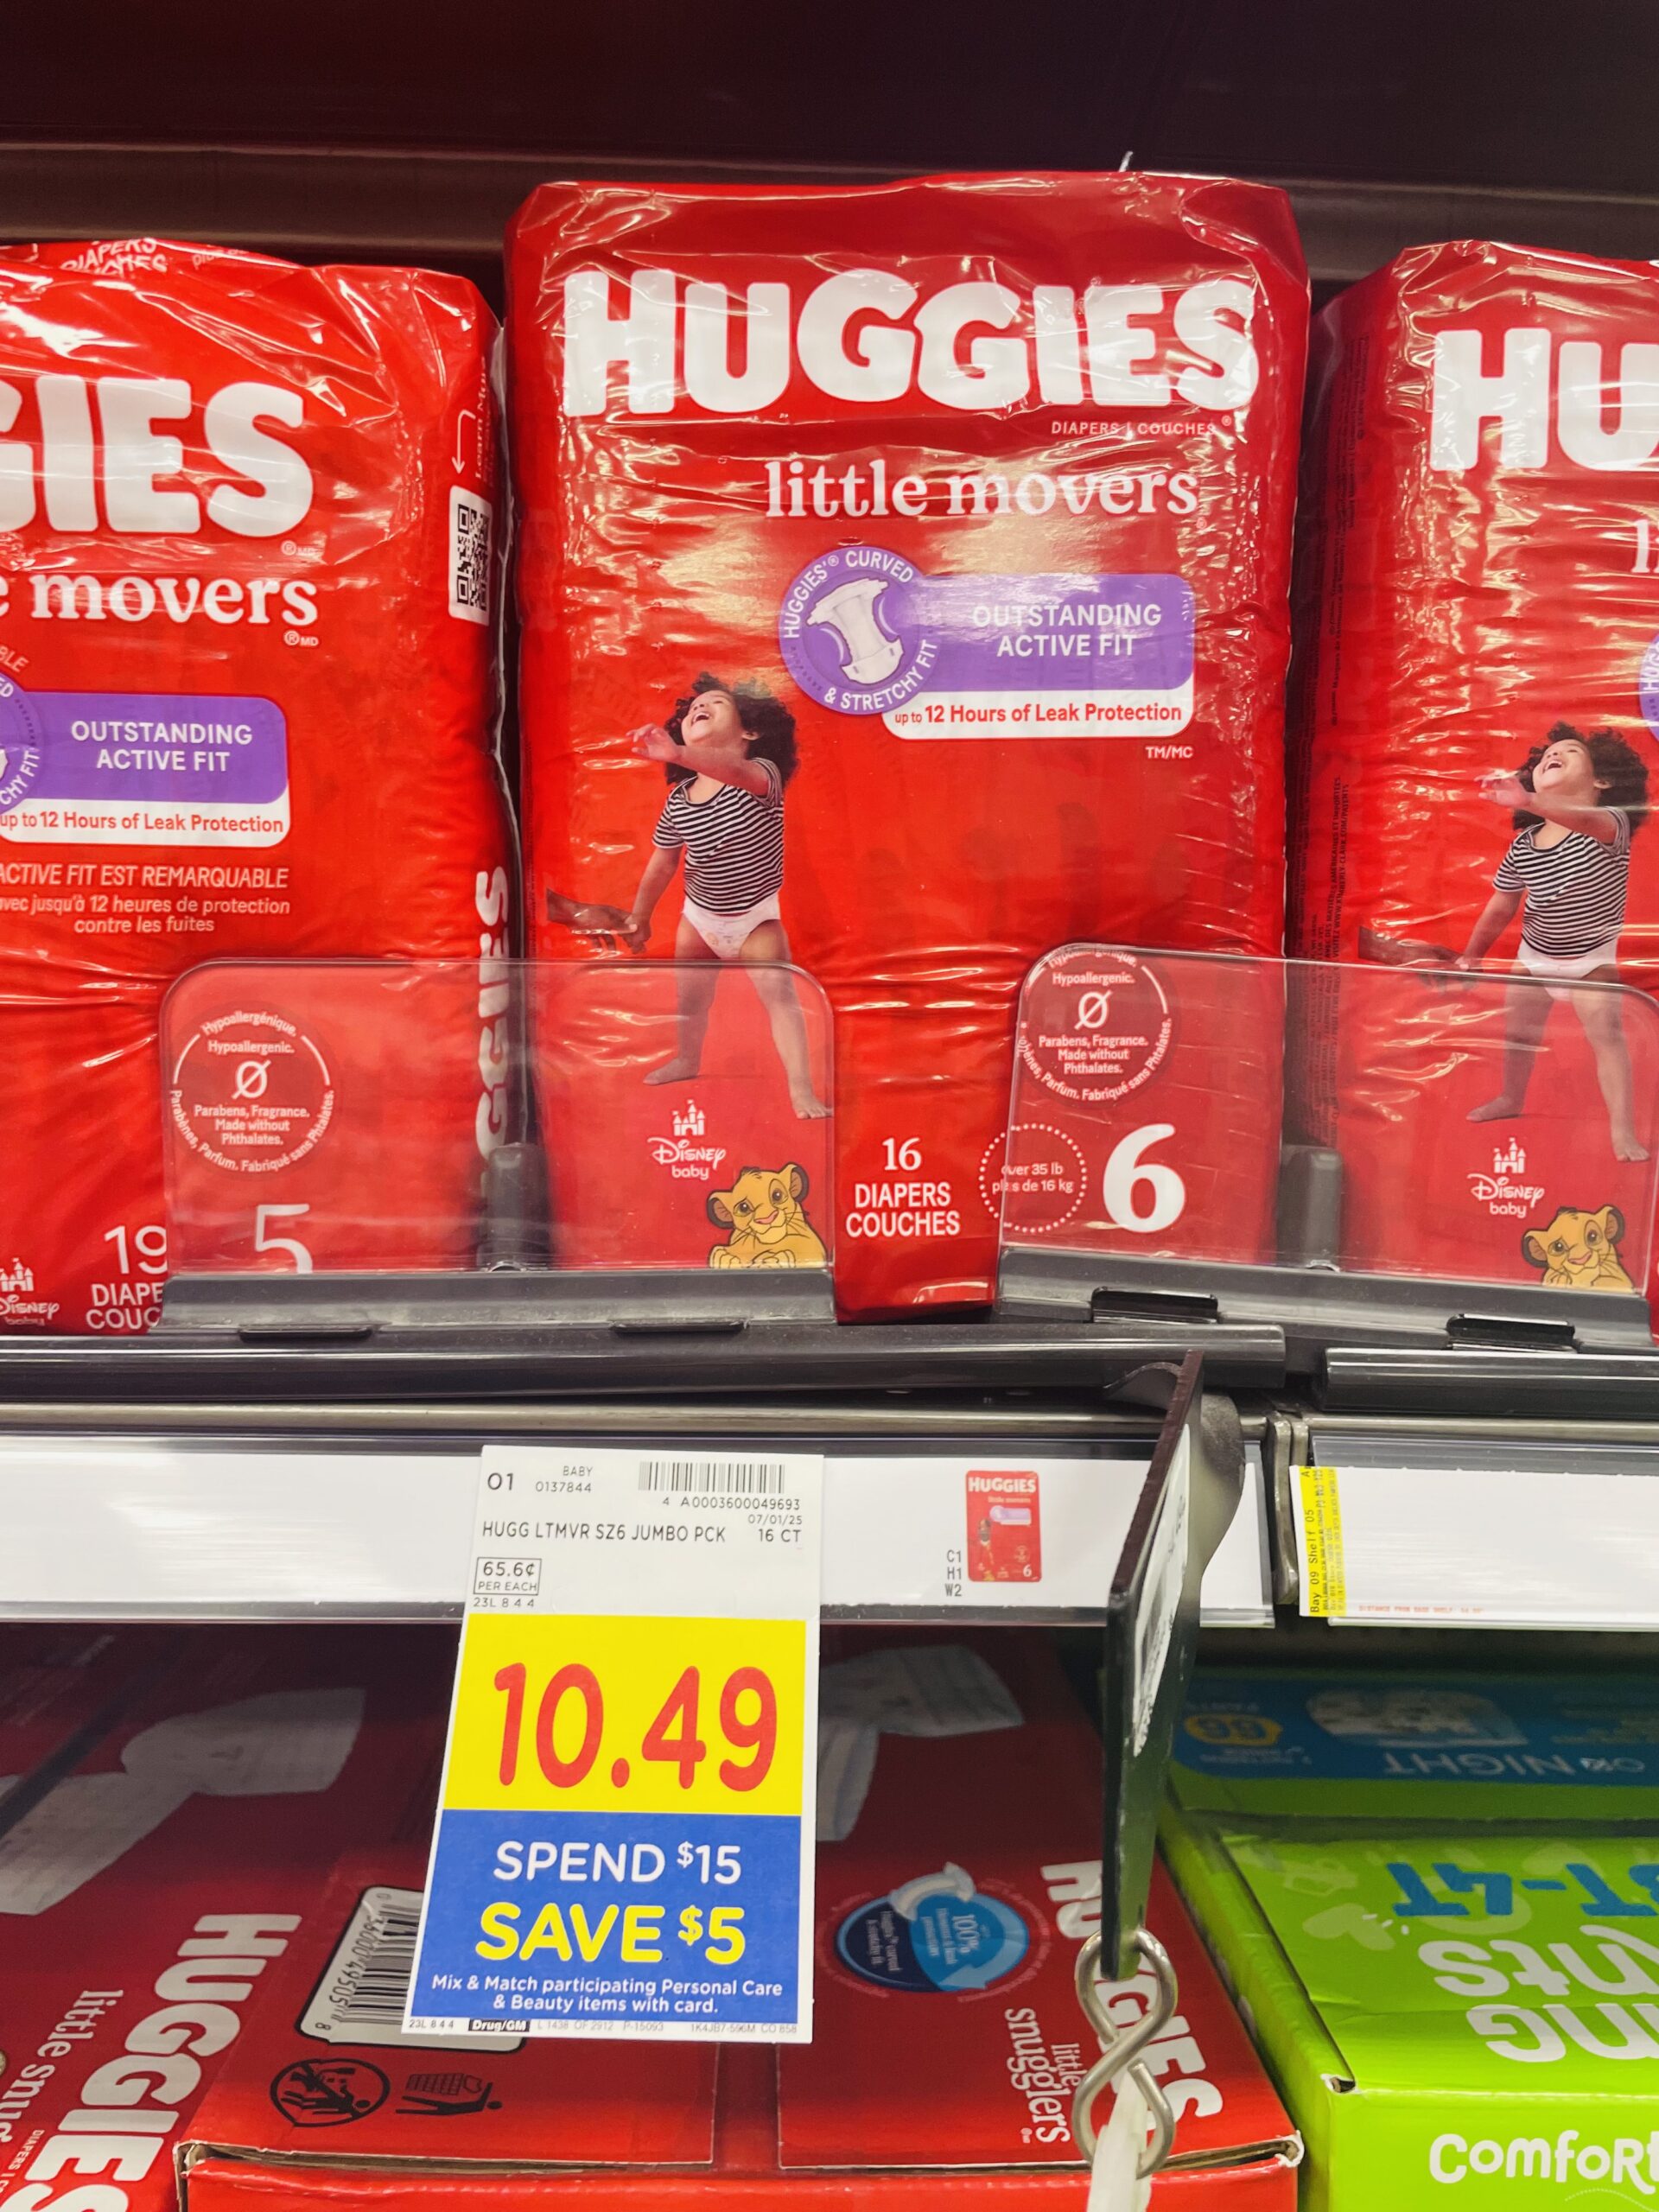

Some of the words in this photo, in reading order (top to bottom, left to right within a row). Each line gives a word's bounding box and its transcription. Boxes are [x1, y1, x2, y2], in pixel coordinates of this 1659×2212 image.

[563, 266, 1261, 418] HUGGIES
[1051, 421, 1120, 435] DIAPERS
[1137, 422, 1217, 435] COUCHES
[0, 374, 315, 537] IES
[764, 459, 931, 518] little
[946, 471, 1199, 516] movers
[845, 550, 914, 583] CURVED
[29, 574, 318, 627] movers
[972, 603, 1163, 627] OUTSTANDING
[996, 633, 1092, 658] ACTIVE
[1098, 633, 1138, 657] FIT
[823, 687, 837, 705] &
[840, 665, 925, 711] STRETCHY
[915, 639, 938, 669] FIT
[894, 713, 909, 727] up
[910, 712, 923, 724] to
[925, 705, 945, 723] 12
[950, 704, 1007, 723] Hours
[1011, 703, 1032, 722] of
[1035, 702, 1080, 721] Leak
[1084, 702, 1182, 721] Protection
[70, 720, 253, 746] OUTSTANDING
[19, 749, 41, 778] FIT
[95, 748, 188, 772] ACTIVE
[193, 750, 232, 772] FIT
[1145, 746, 1194, 760] TM/MC
[0, 815, 18, 831] up
[22, 814, 38, 828] to
[40, 810, 59, 828] 12
[63, 811, 118, 830] Hours
[122, 812, 141, 830] of
[144, 813, 188, 831] Leak
[191, 815, 284, 834] Protection
[66, 863, 97, 886] FIT
[100, 864, 138, 887] EST
[141, 865, 290, 889] REMARQUABLE
[90, 894, 109, 912] 12
[112, 895, 172, 912] heures
[176, 895, 199, 912] de
[202, 897, 290, 916] protection
[74, 918, 131, 933] contre
[136, 917, 162, 932] les
[166, 916, 215, 933] fuites
[1052, 971, 1136, 987] Hypoallergenic.
[200, 1010, 297, 1037] Hypoallergénique.
[474, 865, 511, 1163] GGIES
[207, 1039, 296, 1056] Hypoallergenic.
[1038, 1034, 1091, 1049] Parabens,
[1092, 1034, 1149, 1049] Fragrance.
[1040, 1072, 1081, 1100] Parfum.
[1082, 1081, 1129, 1102] Fabriqué
[1128, 1069, 1151, 1090] sans
[1145, 1017, 1173, 1071] Phtalates.
[1058, 1049, 1087, 1061] Made
[1089, 1048, 1129, 1061] without
[1064, 1062, 1123, 1075] Phthalates.
[193, 1104, 251, 1119] Parabens,
[251, 1104, 311, 1120] Fragrance.
[197, 1142, 239, 1172] Parfum.
[240, 1153, 292, 1173] Fabriqué
[289, 1141, 314, 1161] sans
[308, 1090, 335, 1143] Phtalates.
[214, 1119, 246, 1132] Made
[247, 1119, 291, 1132] without
[221, 1133, 284, 1146] Phthalates.
[646, 1136, 727, 1170] Disney
[880, 1136, 923, 1172] 16
[671, 1165, 710, 1181] baby
[1031, 1163, 1048, 1175] 35
[1050, 1161, 1064, 1175] lb
[1103, 1122, 1186, 1234] 6
[854, 1181, 951, 1209] DIAPERS
[1021, 1179, 1039, 1192] de
[1040, 1179, 1056, 1192] 16
[1058, 1178, 1074, 1194] kg
[1467, 1172, 1545, 1209] Disney
[1489, 1203, 1528, 1219] baby
[844, 1210, 961, 1238] COUCHES
[103, 1224, 168, 1275] 19
[254, 1203, 313, 1273] 5
[90, 1281, 165, 1307] DIAPE
[85, 1306, 162, 1331] COUC
[563, 1465, 594, 1478] BABY
[534, 1480, 593, 1494] 0137844
[968, 1477, 1037, 1493] HUGGIES
[662, 1497, 671, 1507] 4
[747, 1514, 804, 1527] 07/01/25
[1305, 1509, 1315, 1522] 05
[481, 1521, 530, 1539] HUGG
[535, 1522, 591, 1540] LTMVR
[595, 1523, 626, 1541] SZ6
[631, 1524, 690, 1542] JUMBO
[694, 1526, 727, 1543] PCK
[758, 1528, 775, 1543] 16
[780, 1529, 803, 1543] CT
[946, 1549, 962, 1563] C1
[1306, 1529, 1319, 1564] Shelf
[482, 1560, 536, 1578] 65.6¢
[947, 1567, 962, 1580] H1
[1022, 1563, 1033, 1578] 6
[1309, 1571, 1320, 1585] 09
[478, 1580, 501, 1592] PER
[505, 1581, 537, 1592] EACH
[944, 1584, 963, 1598] W2
[513, 1598, 523, 1609] 4
[526, 1598, 535, 1609] 4
[1310, 1592, 1322, 1613] Bay
[493, 1662, 778, 1793] 10.49
[493, 1840, 666, 1884] SPEND
[677, 1841, 742, 1885] $15
[474, 1901, 666, 1964] SAVE
[677, 1904, 746, 1966] $5
[431, 1974, 462, 1991] Mix
[467, 1975, 480, 1992] &
[484, 1975, 537, 1993] Match
[541, 1976, 657, 1998] participating
[661, 1979, 738, 1997] Personal
[741, 1980, 783, 1997] Care
[493, 1994, 505, 2010] &
[510, 1994, 574, 2015] Beauty
[578, 1994, 626, 2013] items
[632, 1995, 670, 2013] with
[674, 1997, 719, 2015] card.
[37, 1990, 124, 2057] little
[315, 2022, 332, 2031] 8
[472, 2018, 527, 2032] Drug/GM
[1004, 2007, 1071, 2145] snugglers
[1049, 2042, 1081, 2088] little
[8, 2129, 45, 2171] DIAPERS
